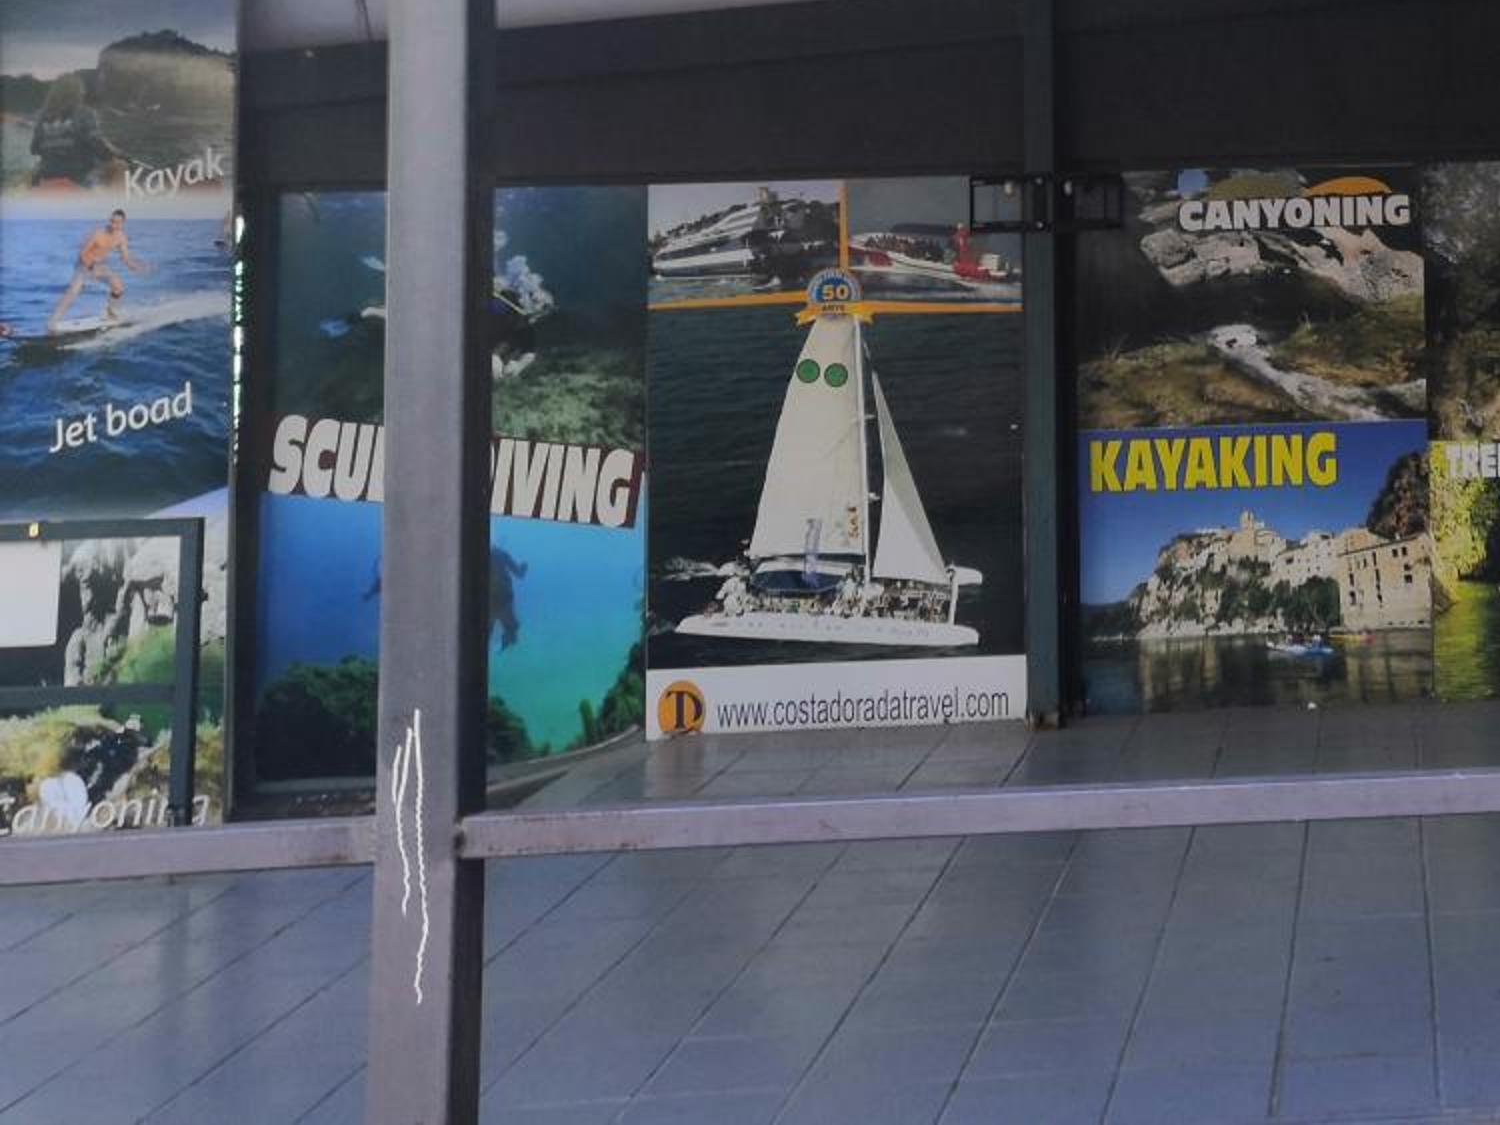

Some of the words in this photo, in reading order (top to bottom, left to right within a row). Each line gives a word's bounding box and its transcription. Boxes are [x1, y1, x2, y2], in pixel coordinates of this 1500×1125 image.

[123, 146, 226, 200] Kayak
[1178, 194, 1411, 232] CANYONING
[821, 283, 849, 300] 50
[50, 412, 98, 454] Jet
[106, 382, 194, 435] boad
[1089, 432, 1338, 493] KAYAKING
[716, 686, 1010, 727] www.costadoradatravel.com
